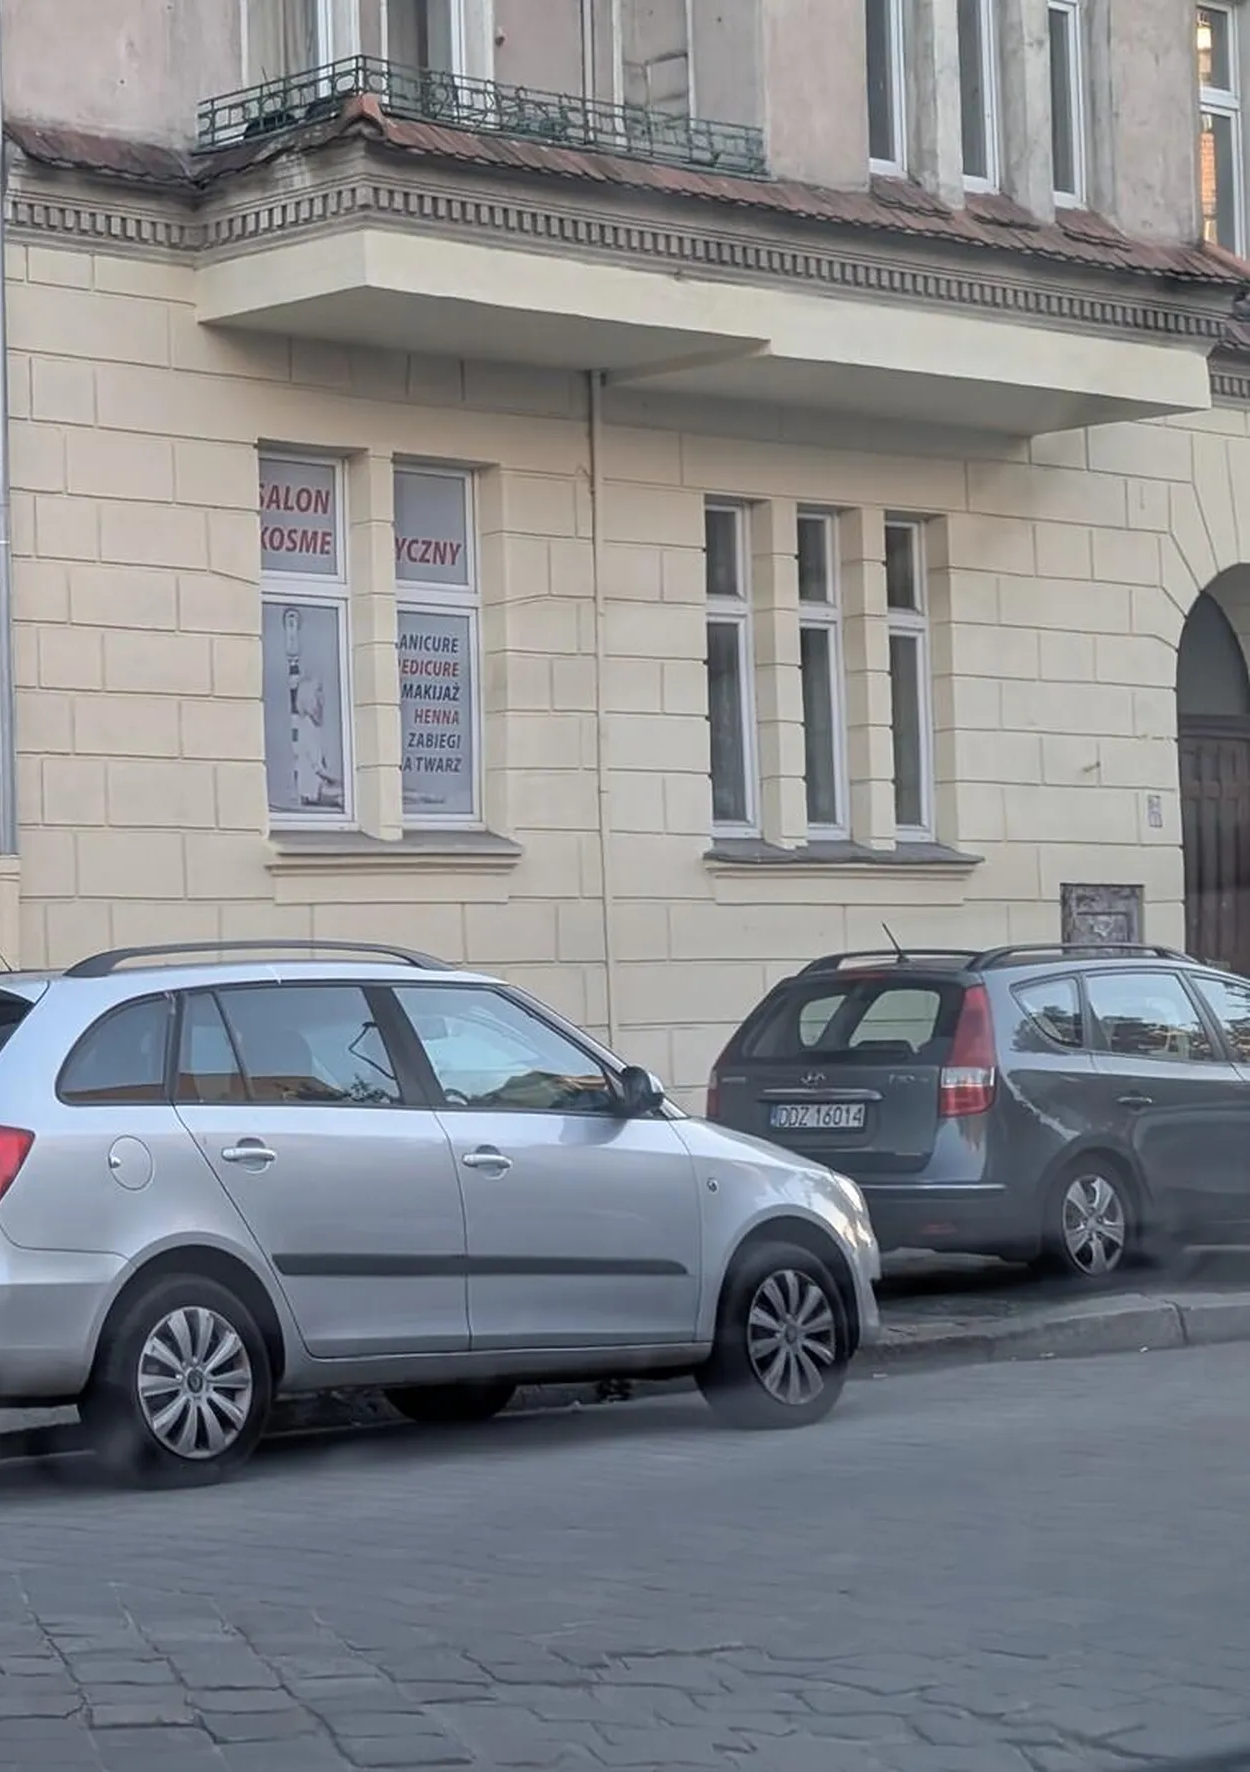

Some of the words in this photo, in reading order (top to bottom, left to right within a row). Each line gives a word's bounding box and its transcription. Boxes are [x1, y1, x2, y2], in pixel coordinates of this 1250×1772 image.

[396, 537, 462, 565] YCZNY
[399, 634, 459, 653] ANICURE
[398, 659, 459, 677] EDICURE
[401, 682, 460, 701] MAKIJAŻ
[414, 708, 459, 725] HENNA
[408, 732, 461, 749] ZABIEGI
[416, 757, 462, 773] TWARZ
[779, 1106, 809, 1126] DDZ
[816, 1106, 862, 1125] 16014
